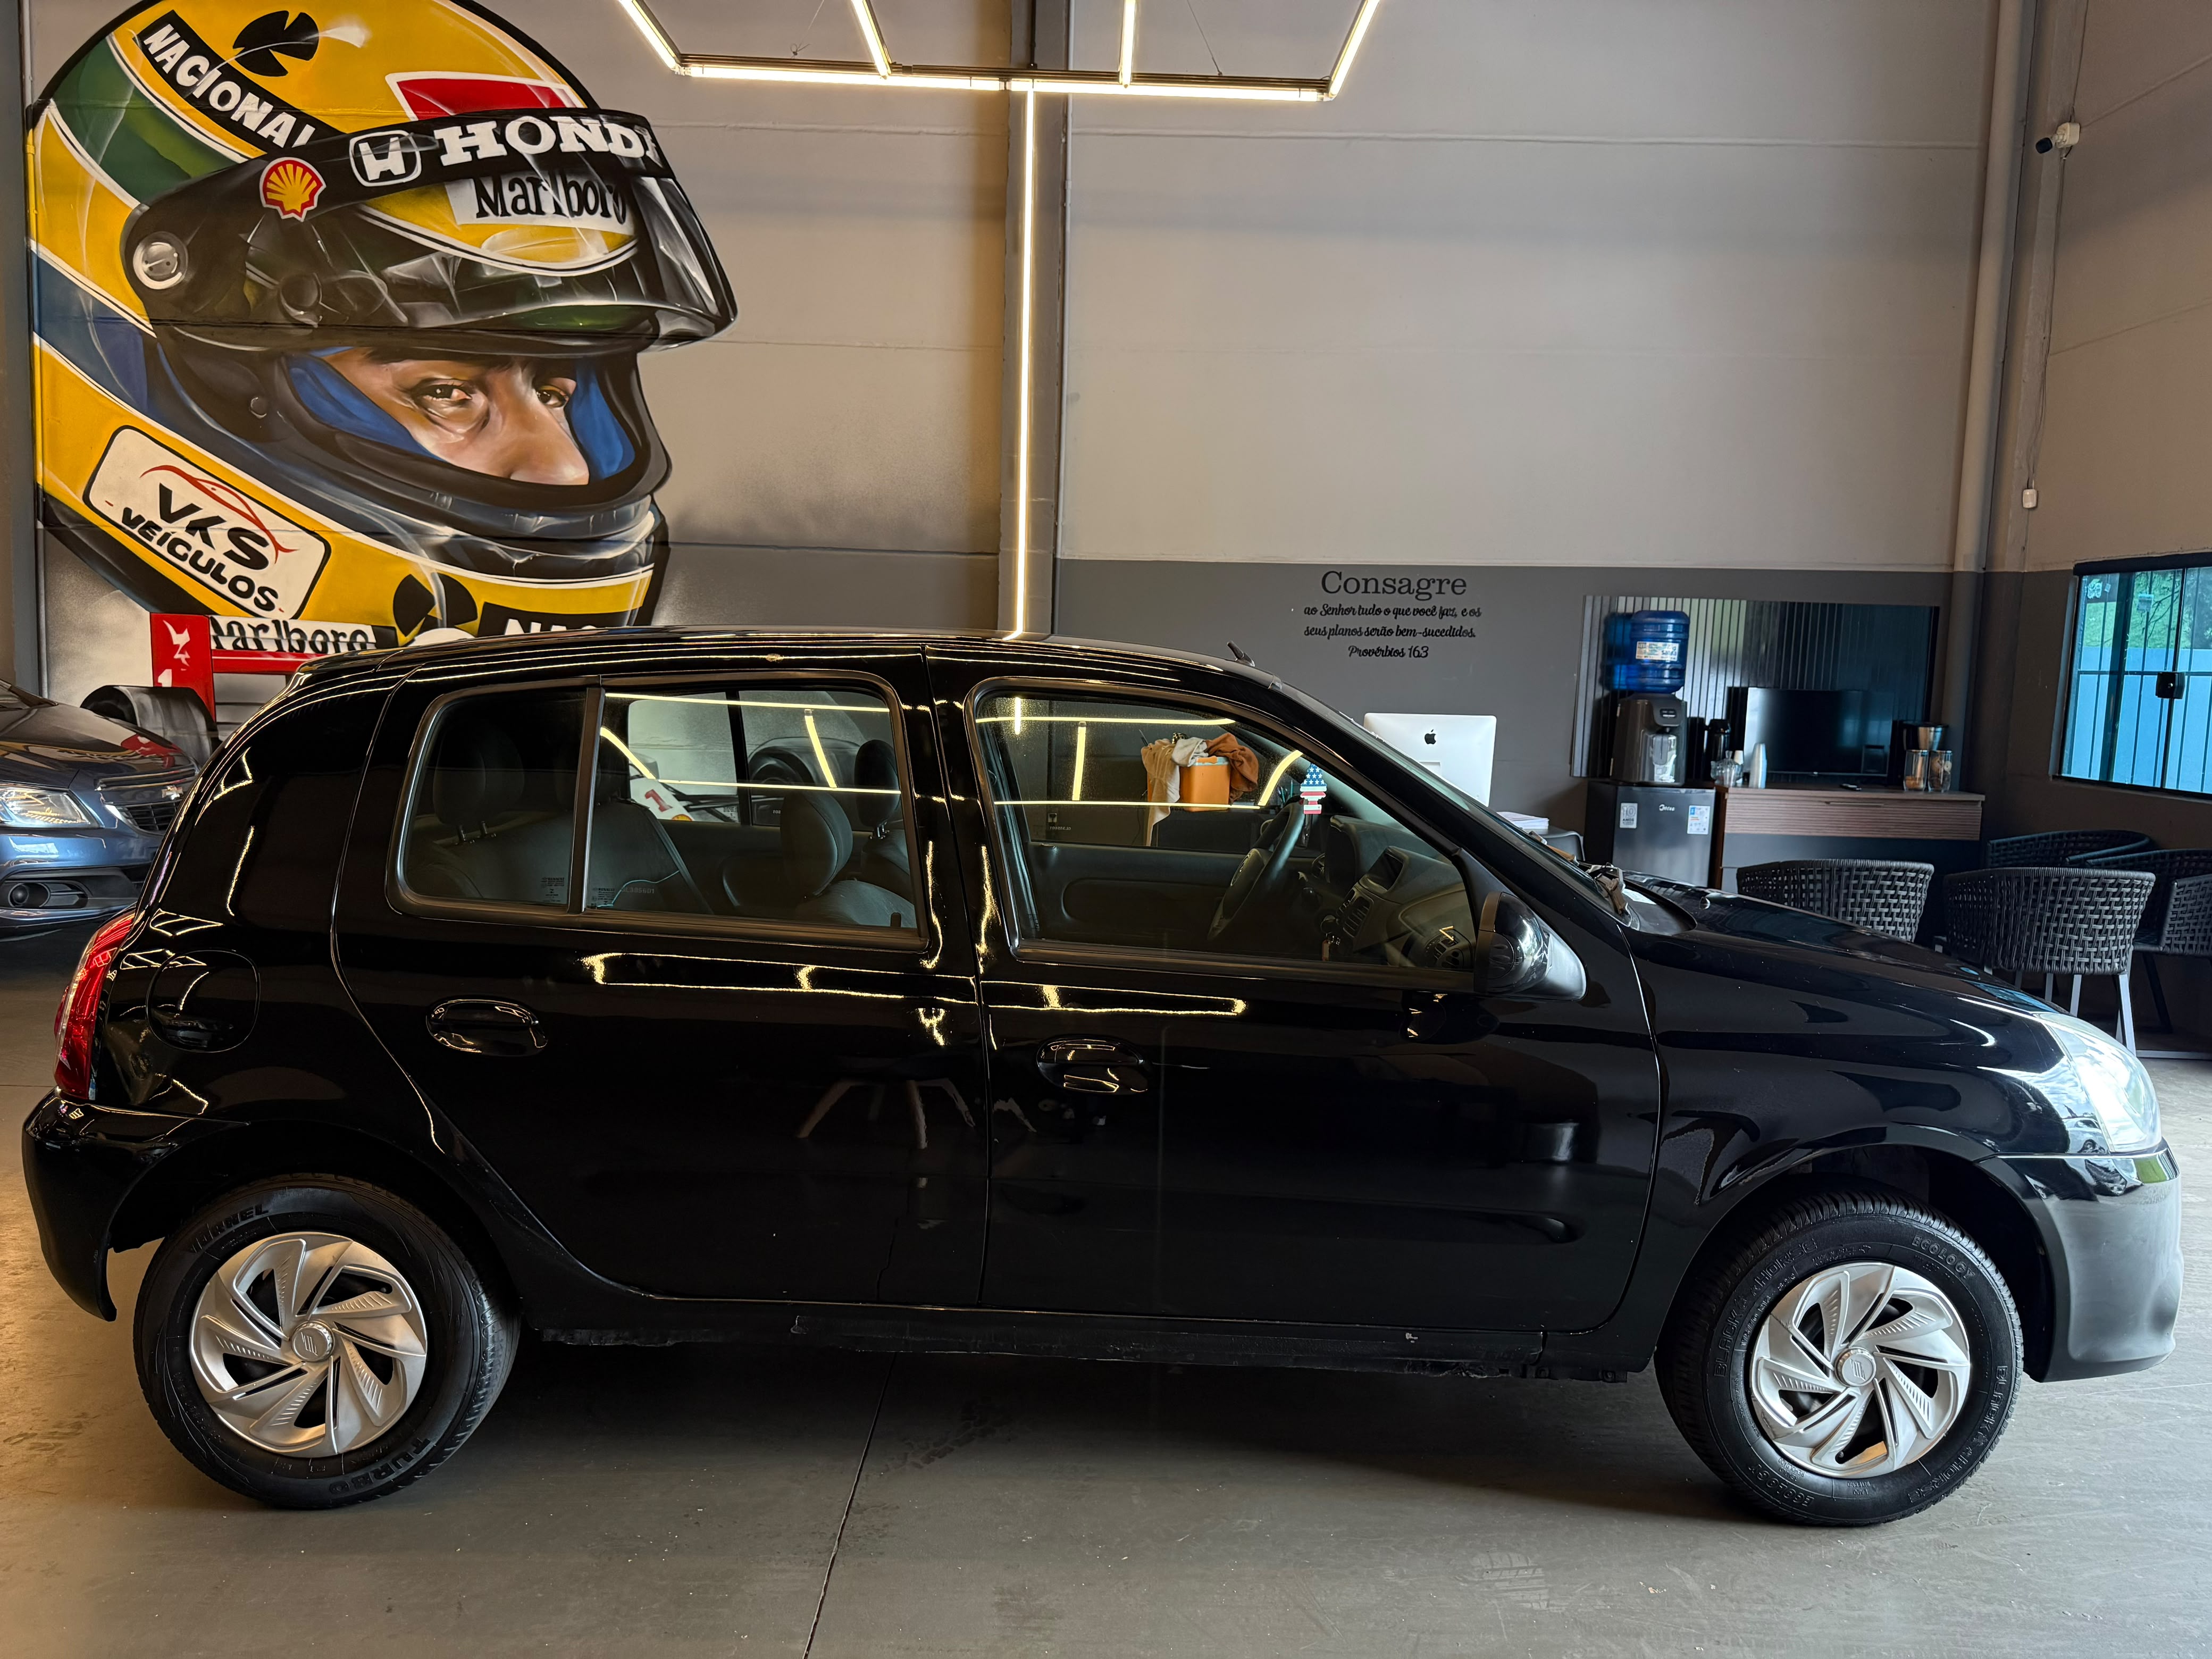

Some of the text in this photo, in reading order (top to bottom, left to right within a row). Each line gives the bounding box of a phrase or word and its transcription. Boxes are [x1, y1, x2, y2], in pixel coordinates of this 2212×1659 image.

[476, 168, 627, 225] Marlboro
[159, 483, 269, 570] VKS
[122, 507, 279, 612] VEÍCULOS
[1321, 571, 1467, 601] Consagre
[1304, 607, 1318, 615] ao
[1320, 604, 1356, 616] Senhor
[1358, 604, 1382, 616] tudo
[1384, 607, 1391, 616] o
[1392, 607, 1411, 620] que
[1413, 605, 1437, 616] você
[1461, 608, 1468, 616] e
[1469, 607, 1481, 617] os
[1304, 626, 1328, 636] seus
[1327, 624, 1363, 640] planos
[1364, 626, 1394, 636] serão
[1348, 645, 1405, 658] Provérbios
[1912, 1234, 1976, 1279] ECOLOGY
[1980, 1365, 2008, 1432] BLACK
[329, 1438, 431, 1494] TURBO
[1907, 1454, 1968, 1504] HORSE
